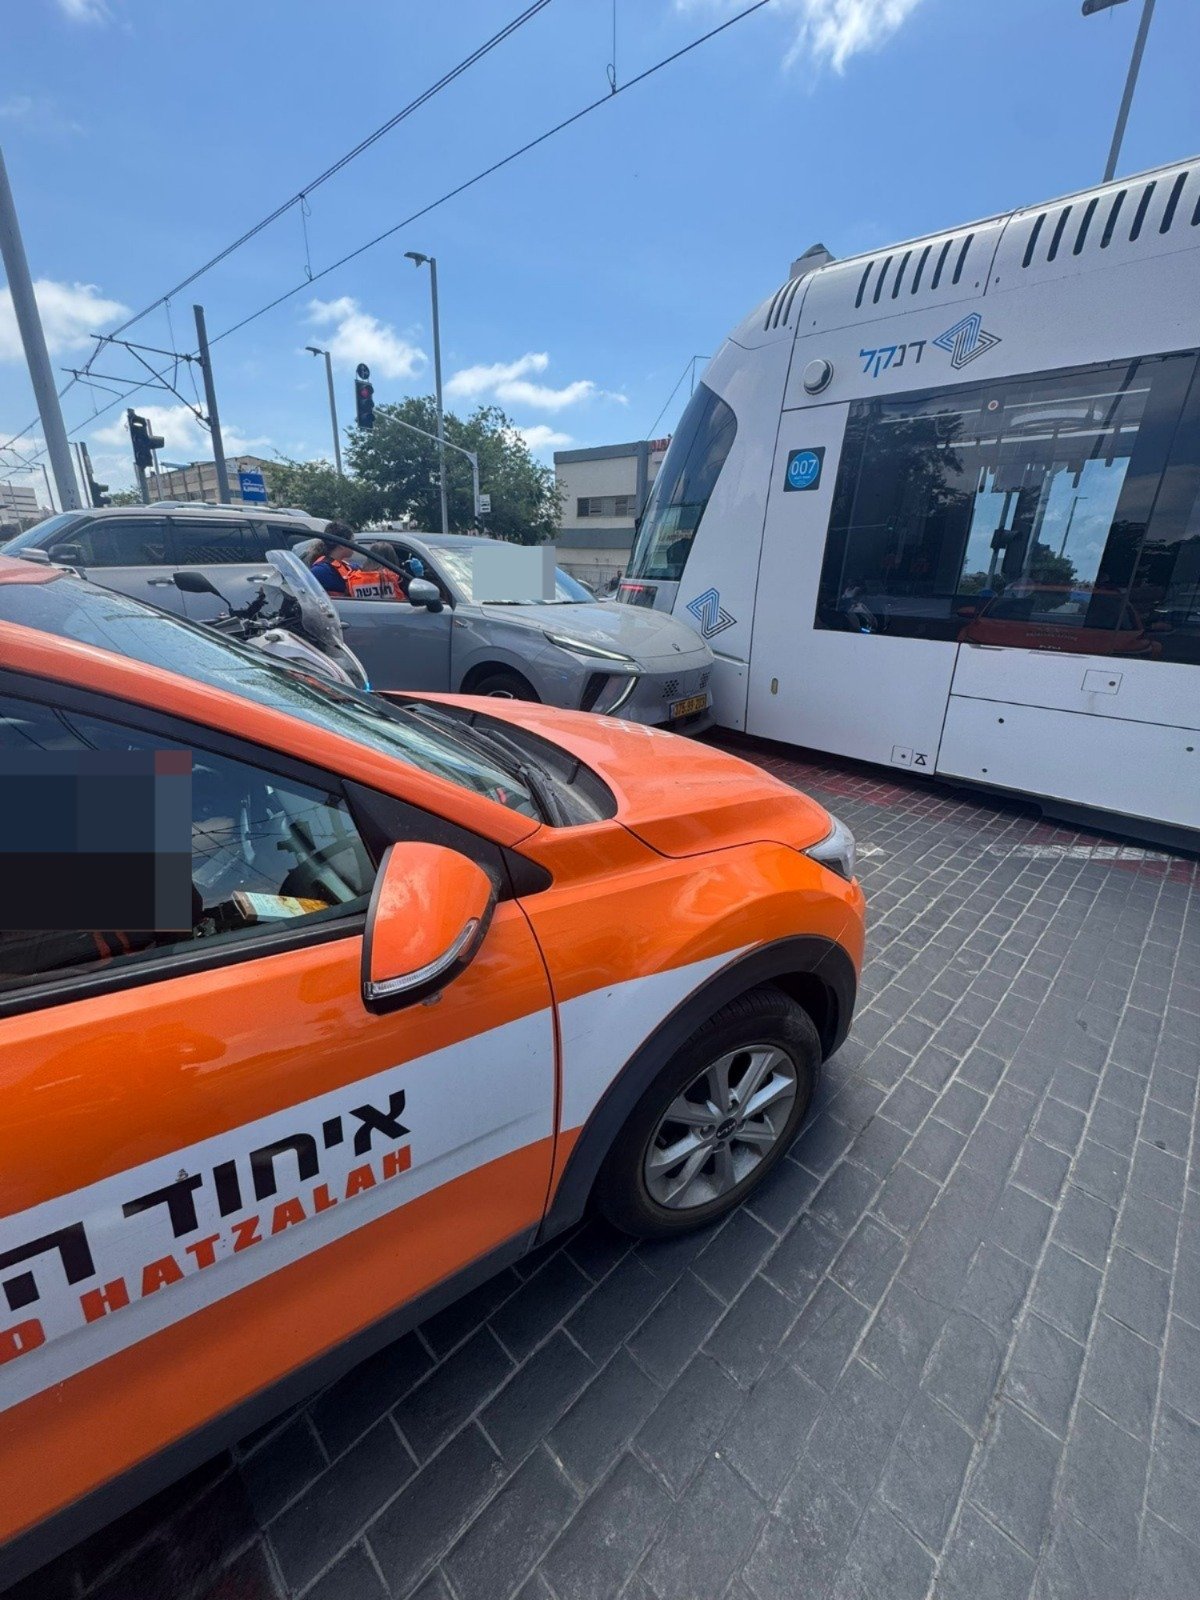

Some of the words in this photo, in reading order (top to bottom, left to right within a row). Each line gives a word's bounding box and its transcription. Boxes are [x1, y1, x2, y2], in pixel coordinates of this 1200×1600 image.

[859, 340, 927, 378] דנקל
[791, 459, 817, 476] 007
[122, 1089, 411, 1238] איחוד
[80, 1144, 412, 1324] HATZALAH
